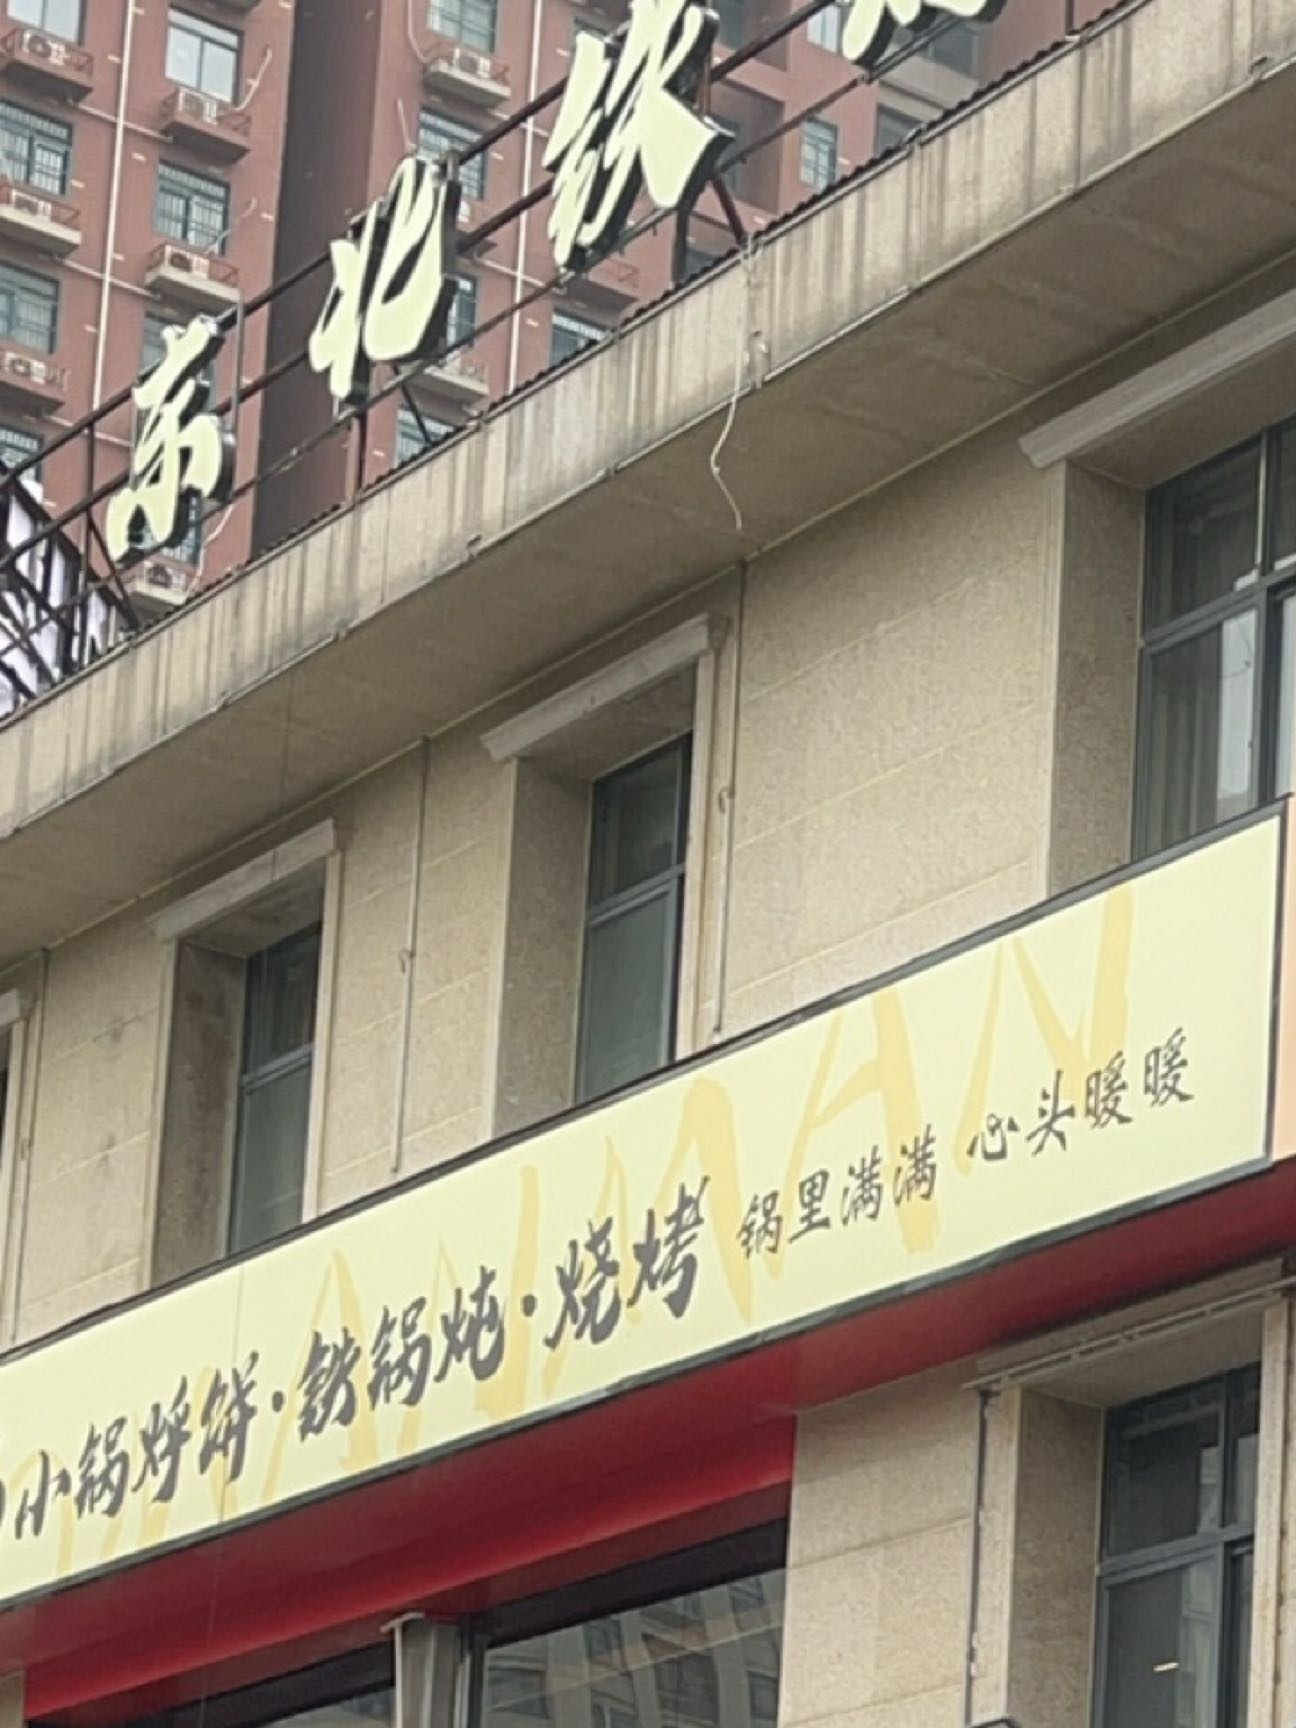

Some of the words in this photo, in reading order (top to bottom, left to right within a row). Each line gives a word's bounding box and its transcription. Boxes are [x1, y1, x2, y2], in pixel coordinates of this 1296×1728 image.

[738, 1124, 937, 1259] 锅里满满
[967, 1027, 1194, 1162] 心头暖暖
